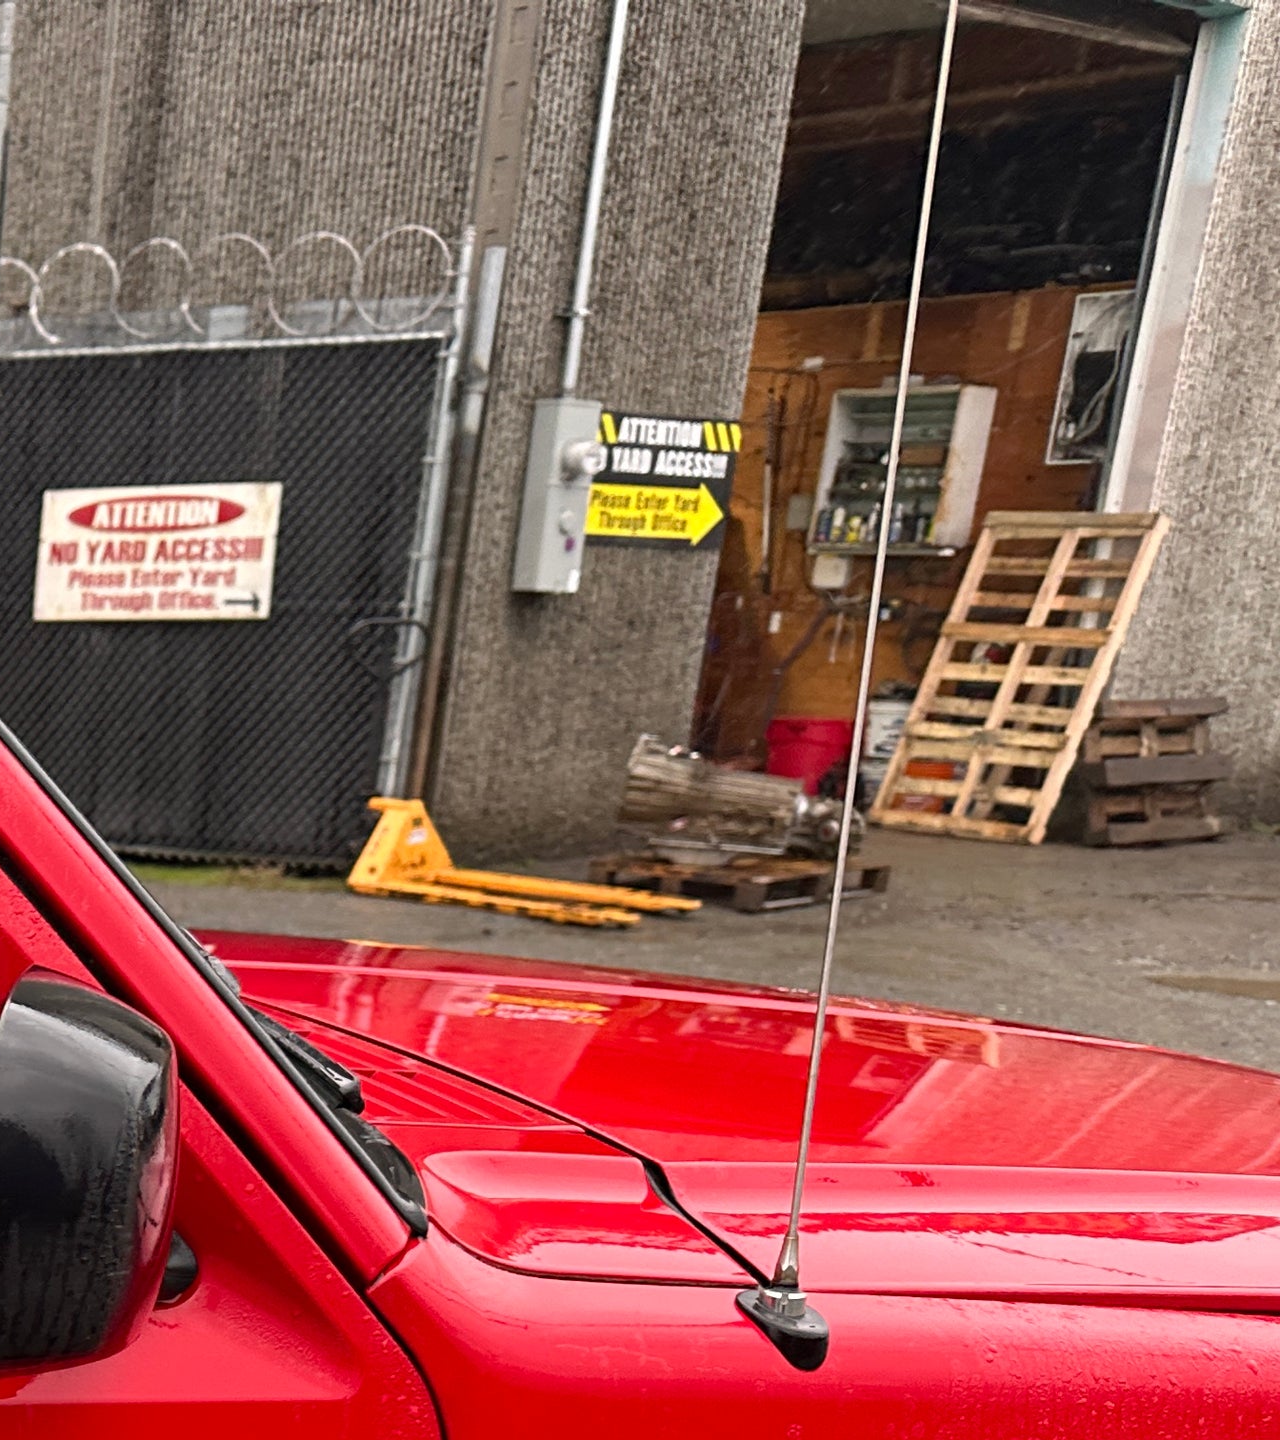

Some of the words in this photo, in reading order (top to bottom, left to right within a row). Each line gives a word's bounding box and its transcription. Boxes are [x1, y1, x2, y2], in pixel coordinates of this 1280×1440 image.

[618, 416, 704, 448] ATTENTION
[611, 446, 653, 475] YARD
[590, 489, 631, 509] Please
[635, 490, 669, 511] Enter
[673, 493, 701, 514] Yard
[91, 499, 219, 530] ATTENTION
[599, 510, 647, 533] Through
[48, 542, 79, 566] NO
[87, 540, 148, 564] YARD
[67, 568, 126, 590] Please
[130, 566, 184, 588] Enter
[188, 566, 237, 587] Yard
[81, 591, 154, 613] Through
